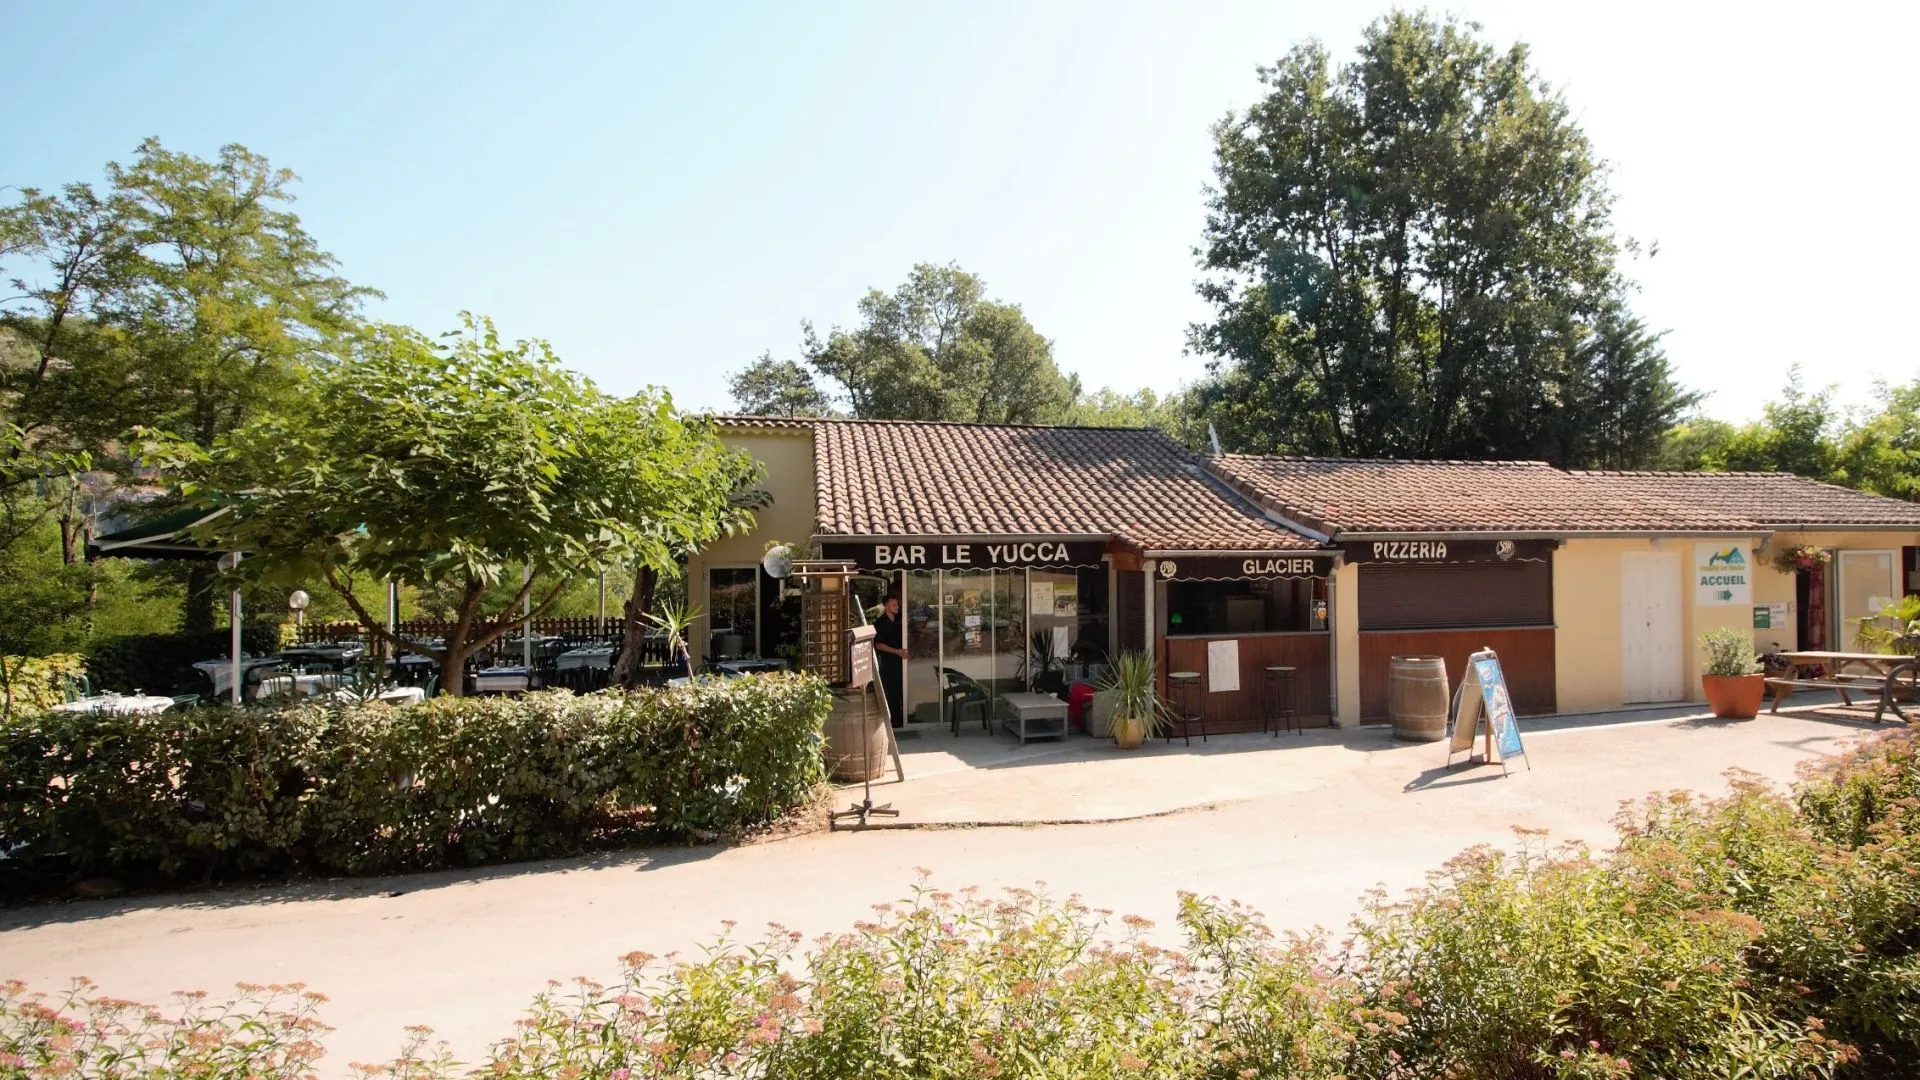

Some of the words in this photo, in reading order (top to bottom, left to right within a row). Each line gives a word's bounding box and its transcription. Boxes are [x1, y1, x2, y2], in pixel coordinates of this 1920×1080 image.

[875, 545, 926, 565] BAR
[942, 544, 971, 564] LE
[987, 542, 1070, 563] YUCCA
[1373, 541, 1447, 559] PIZZERIA
[1242, 559, 1314, 574] GLACIER
[1700, 575, 1746, 586] ACCUEIL
